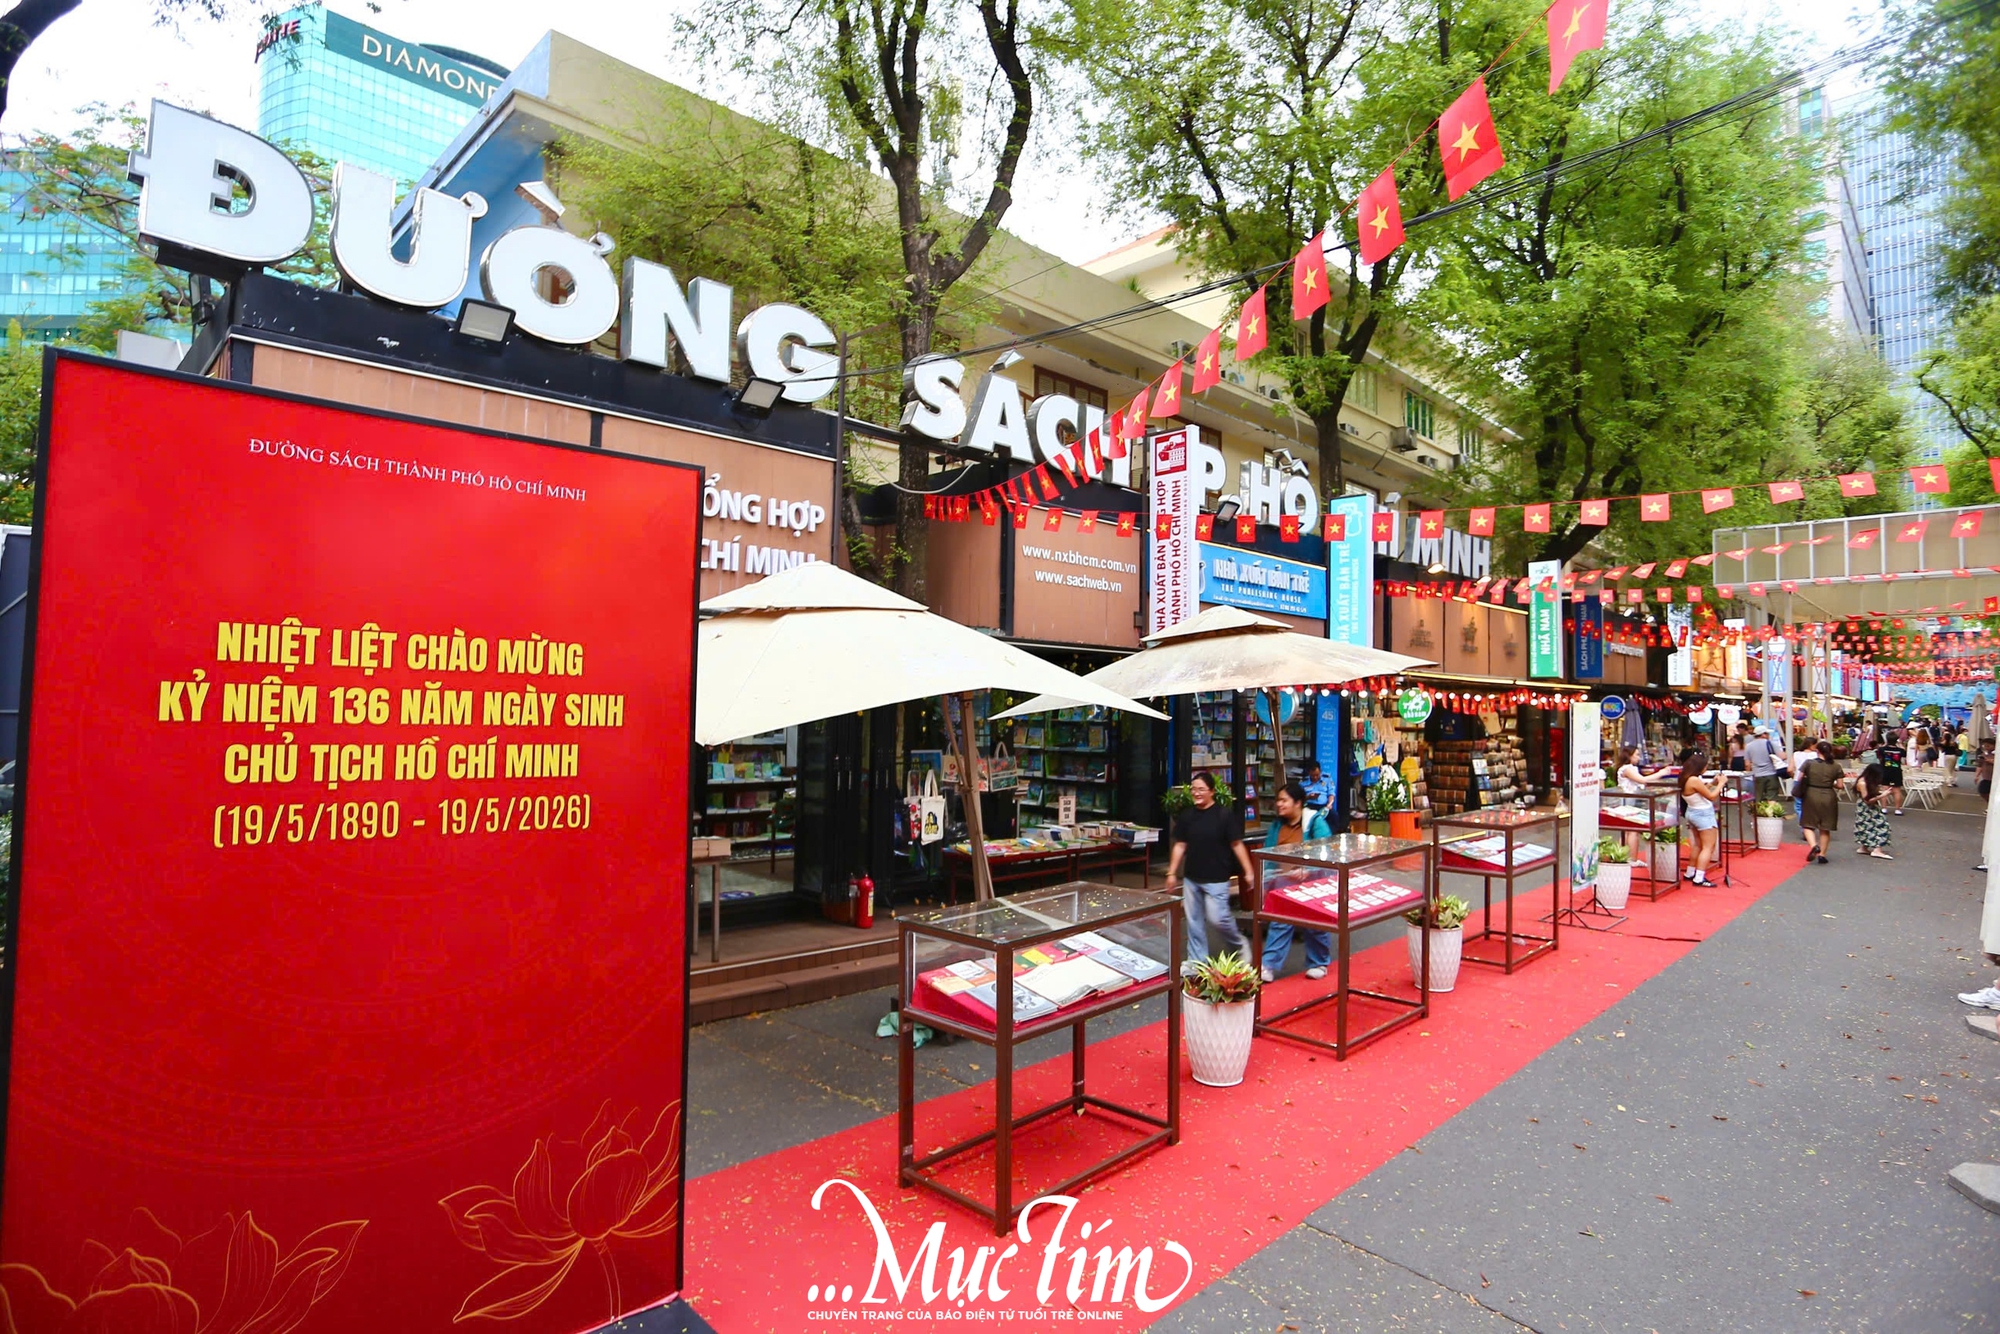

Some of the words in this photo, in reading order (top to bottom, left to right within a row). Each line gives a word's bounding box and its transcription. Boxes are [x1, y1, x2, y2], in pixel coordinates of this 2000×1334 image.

[127, 98, 839, 403] ĐƯỜNG
[899, 349, 1131, 487] SÁCH
[1240, 448, 1319, 534] HỒ
[249, 438, 324, 463] ĐƯỜNG
[329, 449, 380, 472] SÁCH
[385, 458, 447, 483] THÀNH
[451, 468, 485, 487] PHỐ
[489, 473, 512, 491] HỒ
[515, 479, 543, 496] CHÍ
[546, 484, 587, 502] MINH
[703, 473, 762, 523] ỔNG
[767, 497, 825, 538] HỢP
[1156, 480, 1168, 505] HỢP
[1171, 479, 1181, 512] MINH
[1022, 544, 1137, 574] www.nxbhcm.com.vn
[1154, 545, 1166, 570] BẢN
[1169, 539, 1181, 557] HỒ
[1034, 570, 1122, 593] www.sachweb.vn
[1169, 560, 1181, 586] PHỐ
[1213, 557, 1239, 580] NHÀ
[1239, 560, 1268, 586] XUẤT
[1267, 564, 1290, 590] BẢN
[1290, 569, 1310, 593] TRẺ
[1336, 567, 1350, 590] BẢN
[1154, 573, 1166, 604] XUẤT
[1238, 587, 1278, 600] PUBLISHING
[1281, 593, 1302, 604] HOUSE
[1169, 589, 1181, 625] HÀNH
[1336, 593, 1350, 622] XUẤT
[1540, 609, 1551, 631] NAM
[217, 617, 320, 674] NHIỆT
[331, 623, 398, 676] LIỆT
[407, 628, 487, 673] CHÀO
[497, 632, 584, 677] MỪNG
[1538, 633, 1551, 655] NHÃ
[158, 668, 210, 723] KỶ
[222, 675, 317, 731] NIỆM
[329, 686, 390, 726] 136
[400, 681, 473, 727] NĂM
[482, 684, 556, 727] NGÀY
[564, 693, 625, 728] SINH
[224, 732, 298, 784] CHỦ
[309, 742, 384, 790] TỊCH
[394, 735, 440, 781] HỒ
[447, 736, 497, 780] CHÍ
[505, 743, 579, 778] MINH
[213, 800, 400, 849] (19/5/1890
[438, 793, 591, 836] 19/5/2026)
